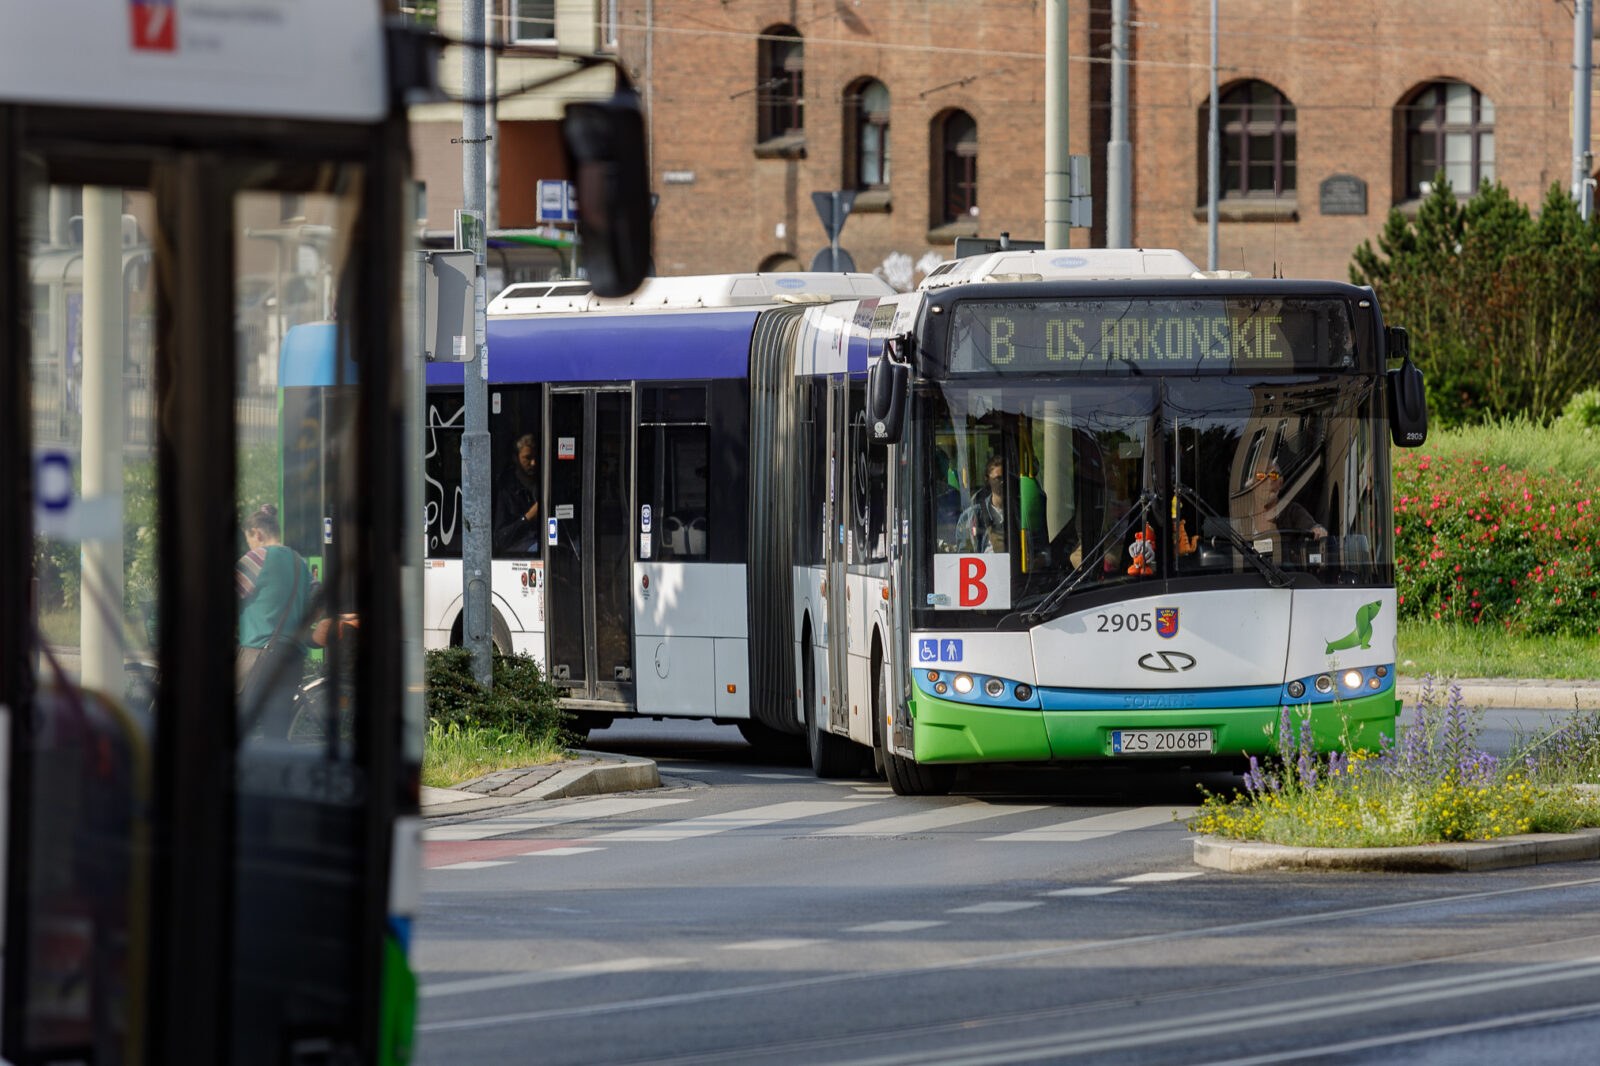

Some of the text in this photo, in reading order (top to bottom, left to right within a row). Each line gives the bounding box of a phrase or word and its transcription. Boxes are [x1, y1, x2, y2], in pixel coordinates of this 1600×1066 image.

[991, 317, 1015, 364] B
[1406, 432, 1424, 440] 2905
[959, 557, 989, 607] B
[1097, 613, 1152, 632] 2905
[1123, 694, 1196, 709] SOLARIS
[1124, 732, 1208, 750] ZS 2068P
